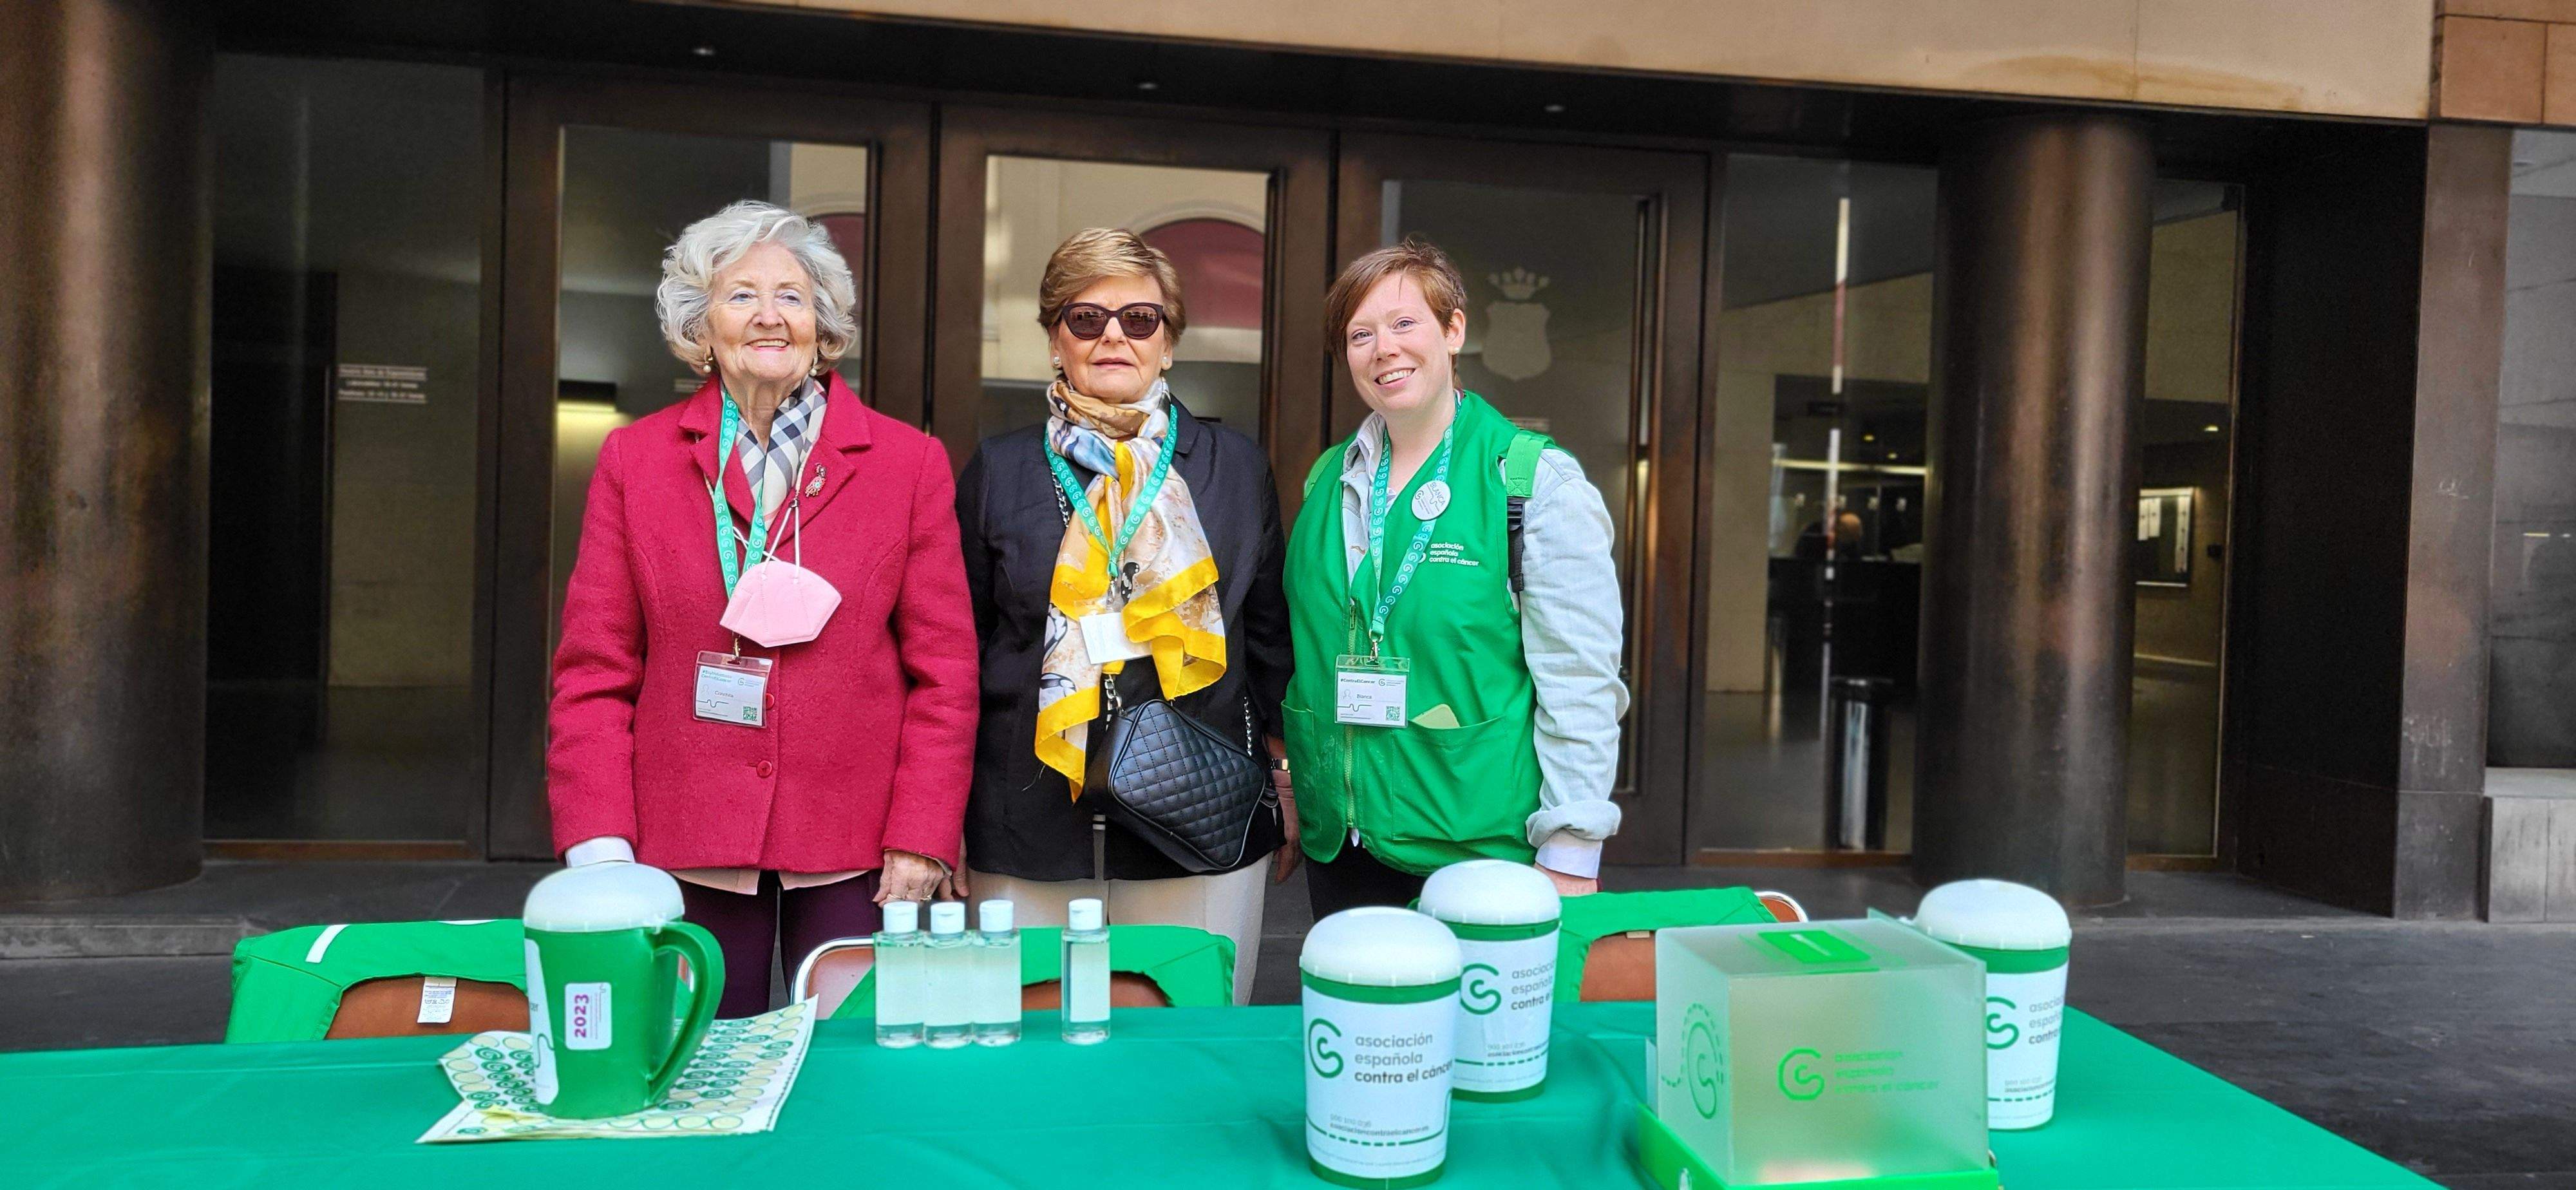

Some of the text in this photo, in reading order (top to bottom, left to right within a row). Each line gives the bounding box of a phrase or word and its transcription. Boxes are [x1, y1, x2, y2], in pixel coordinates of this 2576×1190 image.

[1431, 542, 1464, 551] asociación
[1511, 996, 1544, 1010] contra
[574, 994, 589, 1038] 2023
[1355, 1032, 1433, 1047] asociación
[1354, 1051, 1423, 1068] española
[1354, 1059, 1453, 1084] contra el cáncer
